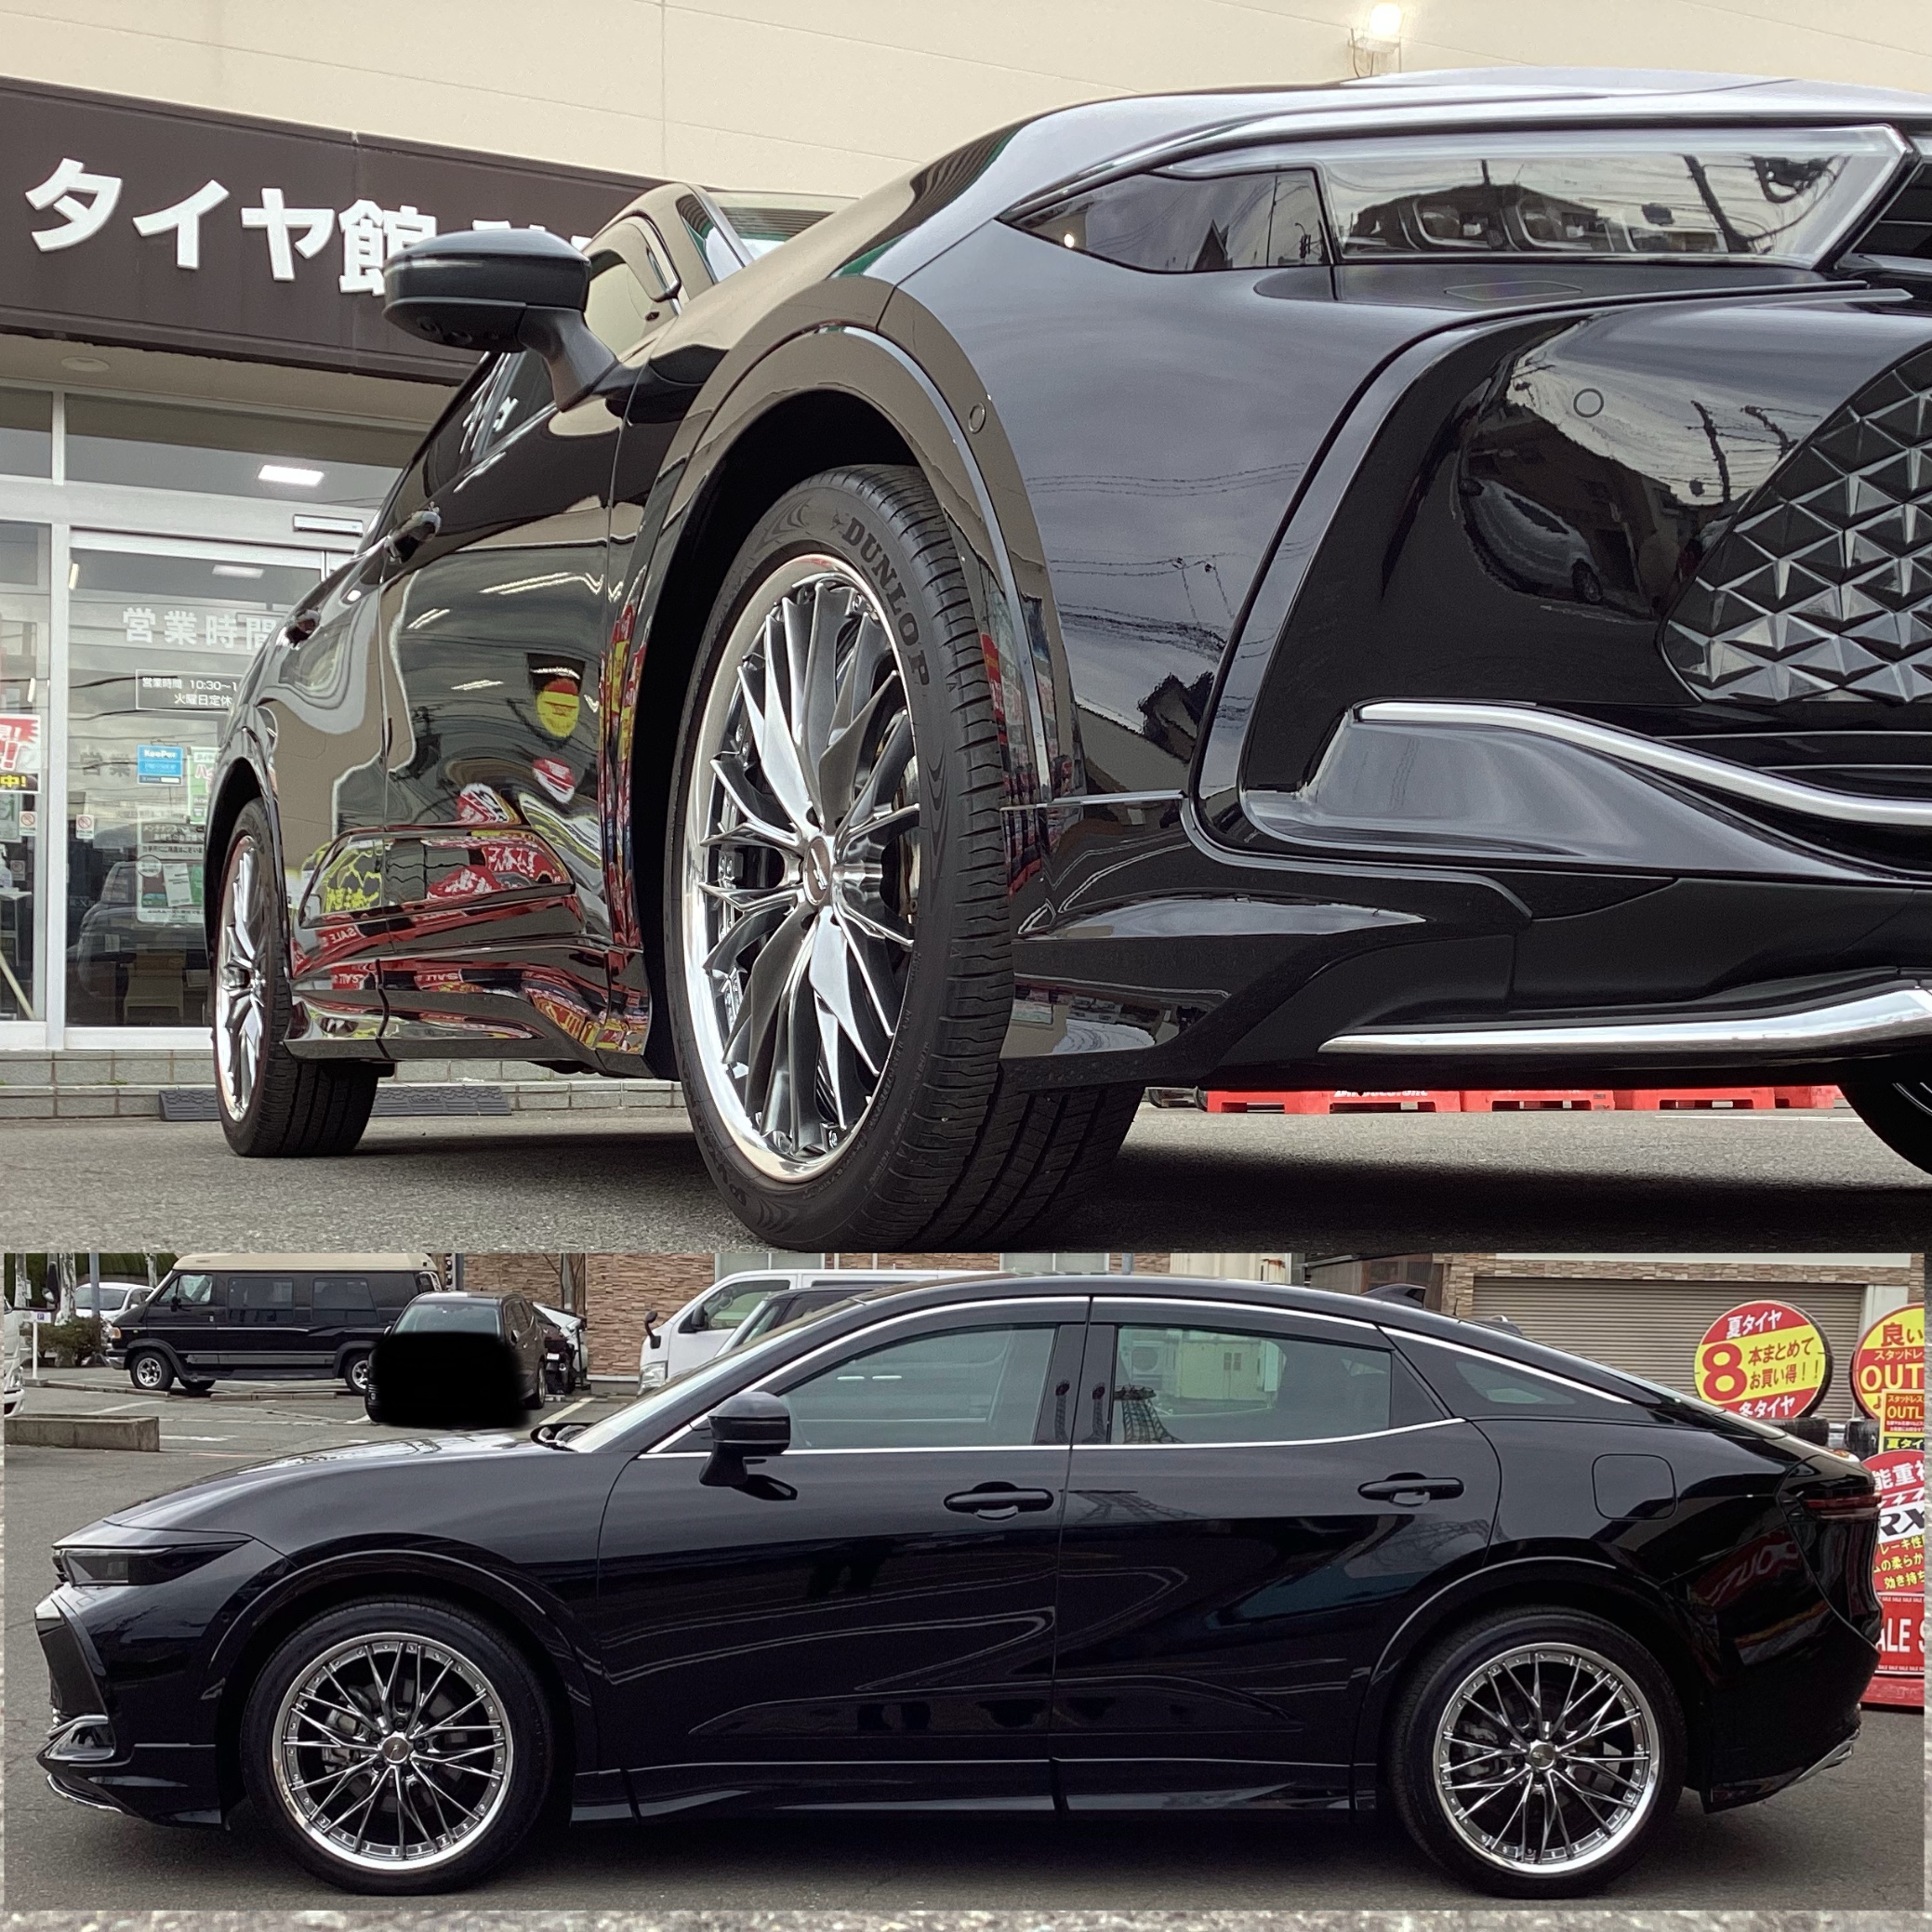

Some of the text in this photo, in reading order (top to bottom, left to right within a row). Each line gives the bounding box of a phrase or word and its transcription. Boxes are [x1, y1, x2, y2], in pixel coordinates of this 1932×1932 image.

[841, 517, 930, 685] DUNLOP
[123, 607, 277, 650] 営業時間
[141, 677, 183, 689] 営業時間
[1727, 1310, 1782, 1339] 夏タイヤ
[1881, 1322, 1924, 1347] 良い
[1748, 1337, 1814, 1367] 本まとめて
[1873, 1349, 1925, 1361] スタッドレ
[1860, 1363, 1925, 1392] OUT
[1739, 1396, 1795, 1418] 冬タイヤ
[1888, 1395, 1925, 1403] スタッドレス
[1887, 1406, 1925, 1419] OUTL
[1879, 1534, 1925, 1555] レーキ性
